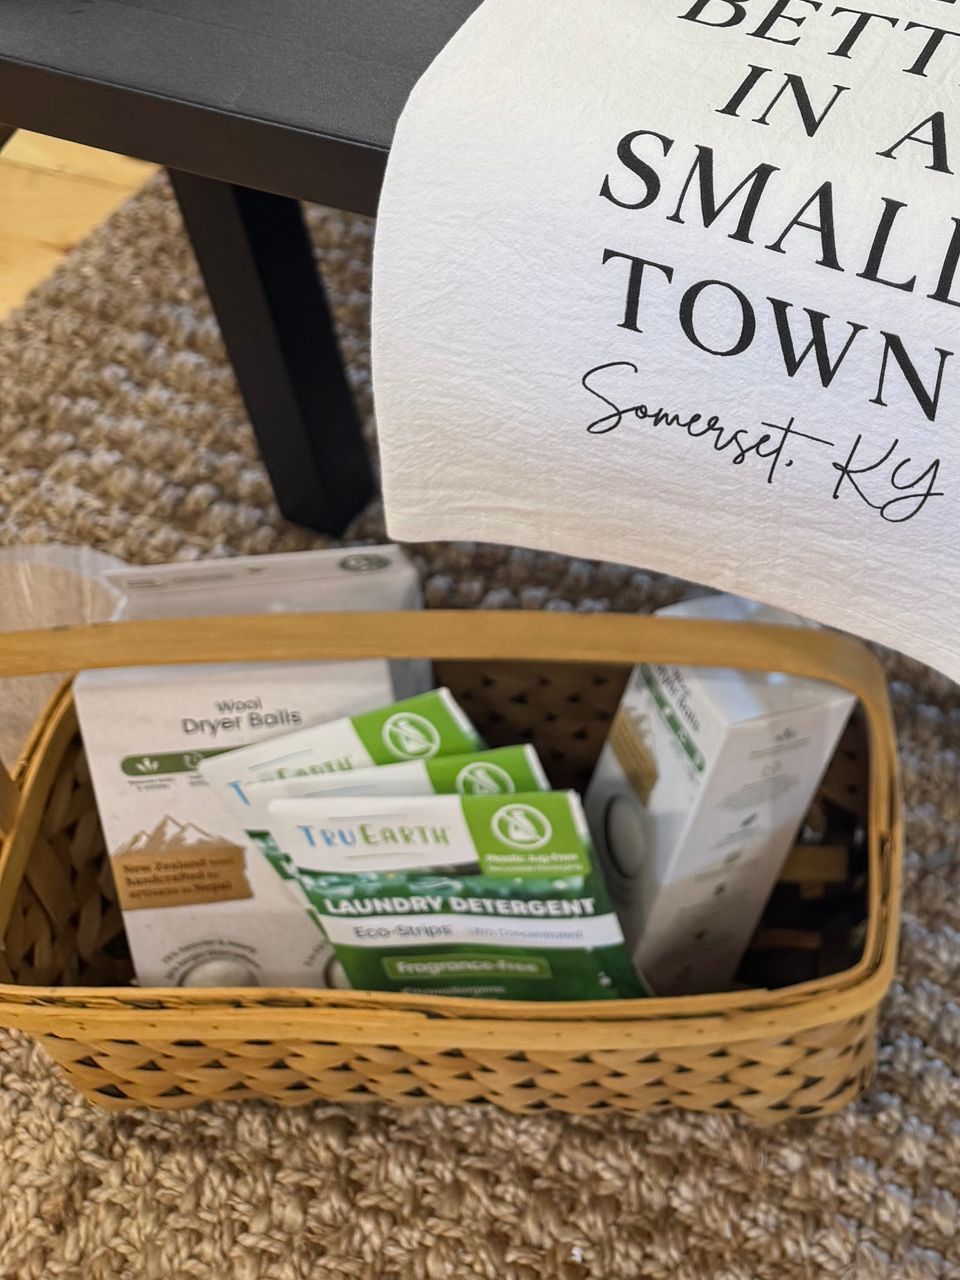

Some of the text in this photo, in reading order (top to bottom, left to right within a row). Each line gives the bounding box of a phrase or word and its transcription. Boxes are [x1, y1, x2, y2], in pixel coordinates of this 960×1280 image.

[715, 64, 954, 175] IN A
[602, 248, 954, 422] TOWN
[832, 434, 944, 523] KY
[215, 697, 263, 713] Wool
[181, 708, 303, 737] Dryer Balls
[323, 896, 595, 916] LAUNDRY DETERGENT
[353, 924, 453, 939] Eco-Strips
